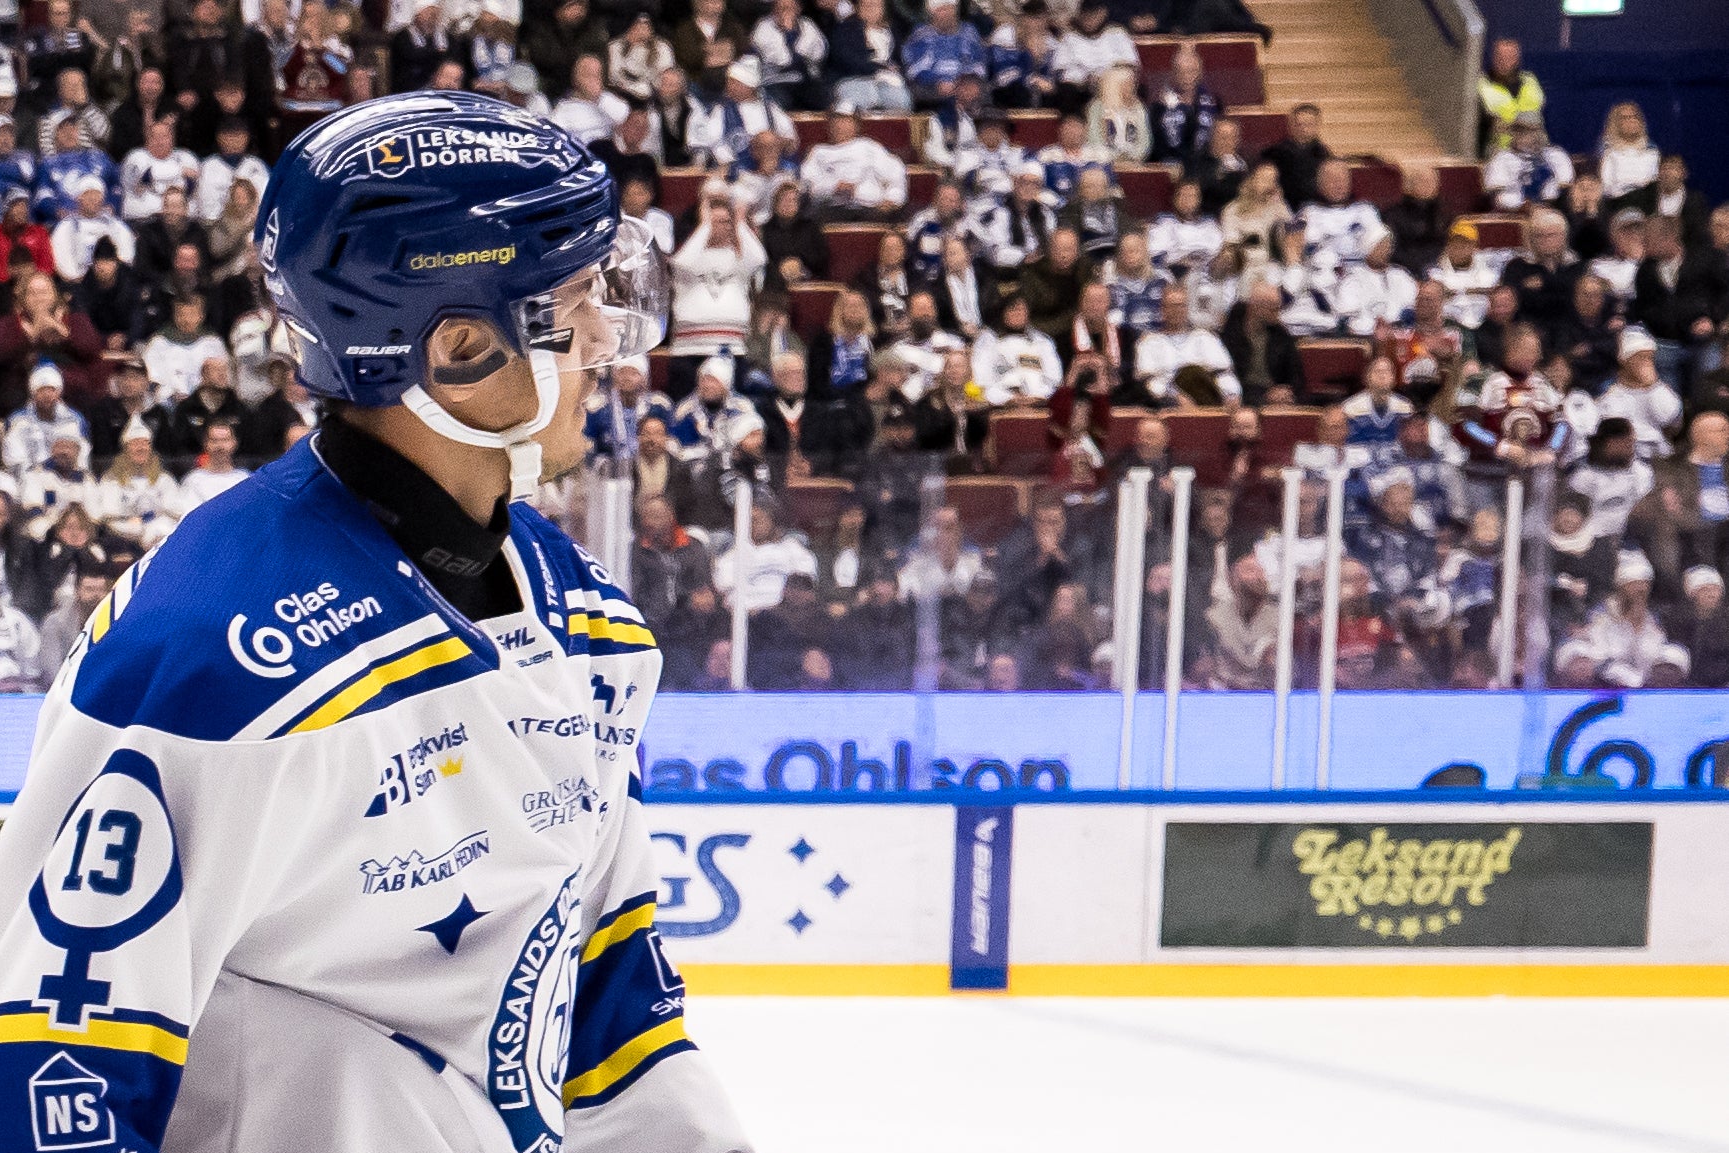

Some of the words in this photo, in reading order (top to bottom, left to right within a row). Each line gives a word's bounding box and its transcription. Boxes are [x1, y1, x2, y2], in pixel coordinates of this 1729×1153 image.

[417, 130, 538, 150] LEKSANDS
[420, 147, 521, 168] DÖRREN
[410, 244, 517, 271] dalaenergi
[274, 581, 340, 623] Clas
[296, 596, 384, 649] Ohlson
[60, 807, 144, 898] 13
[1292, 826, 1523, 875] Leksand
[1310, 871, 1487, 918] Resort
[496, 916, 558, 1111] LEKSANDS
[44, 1091, 101, 1136] NS
